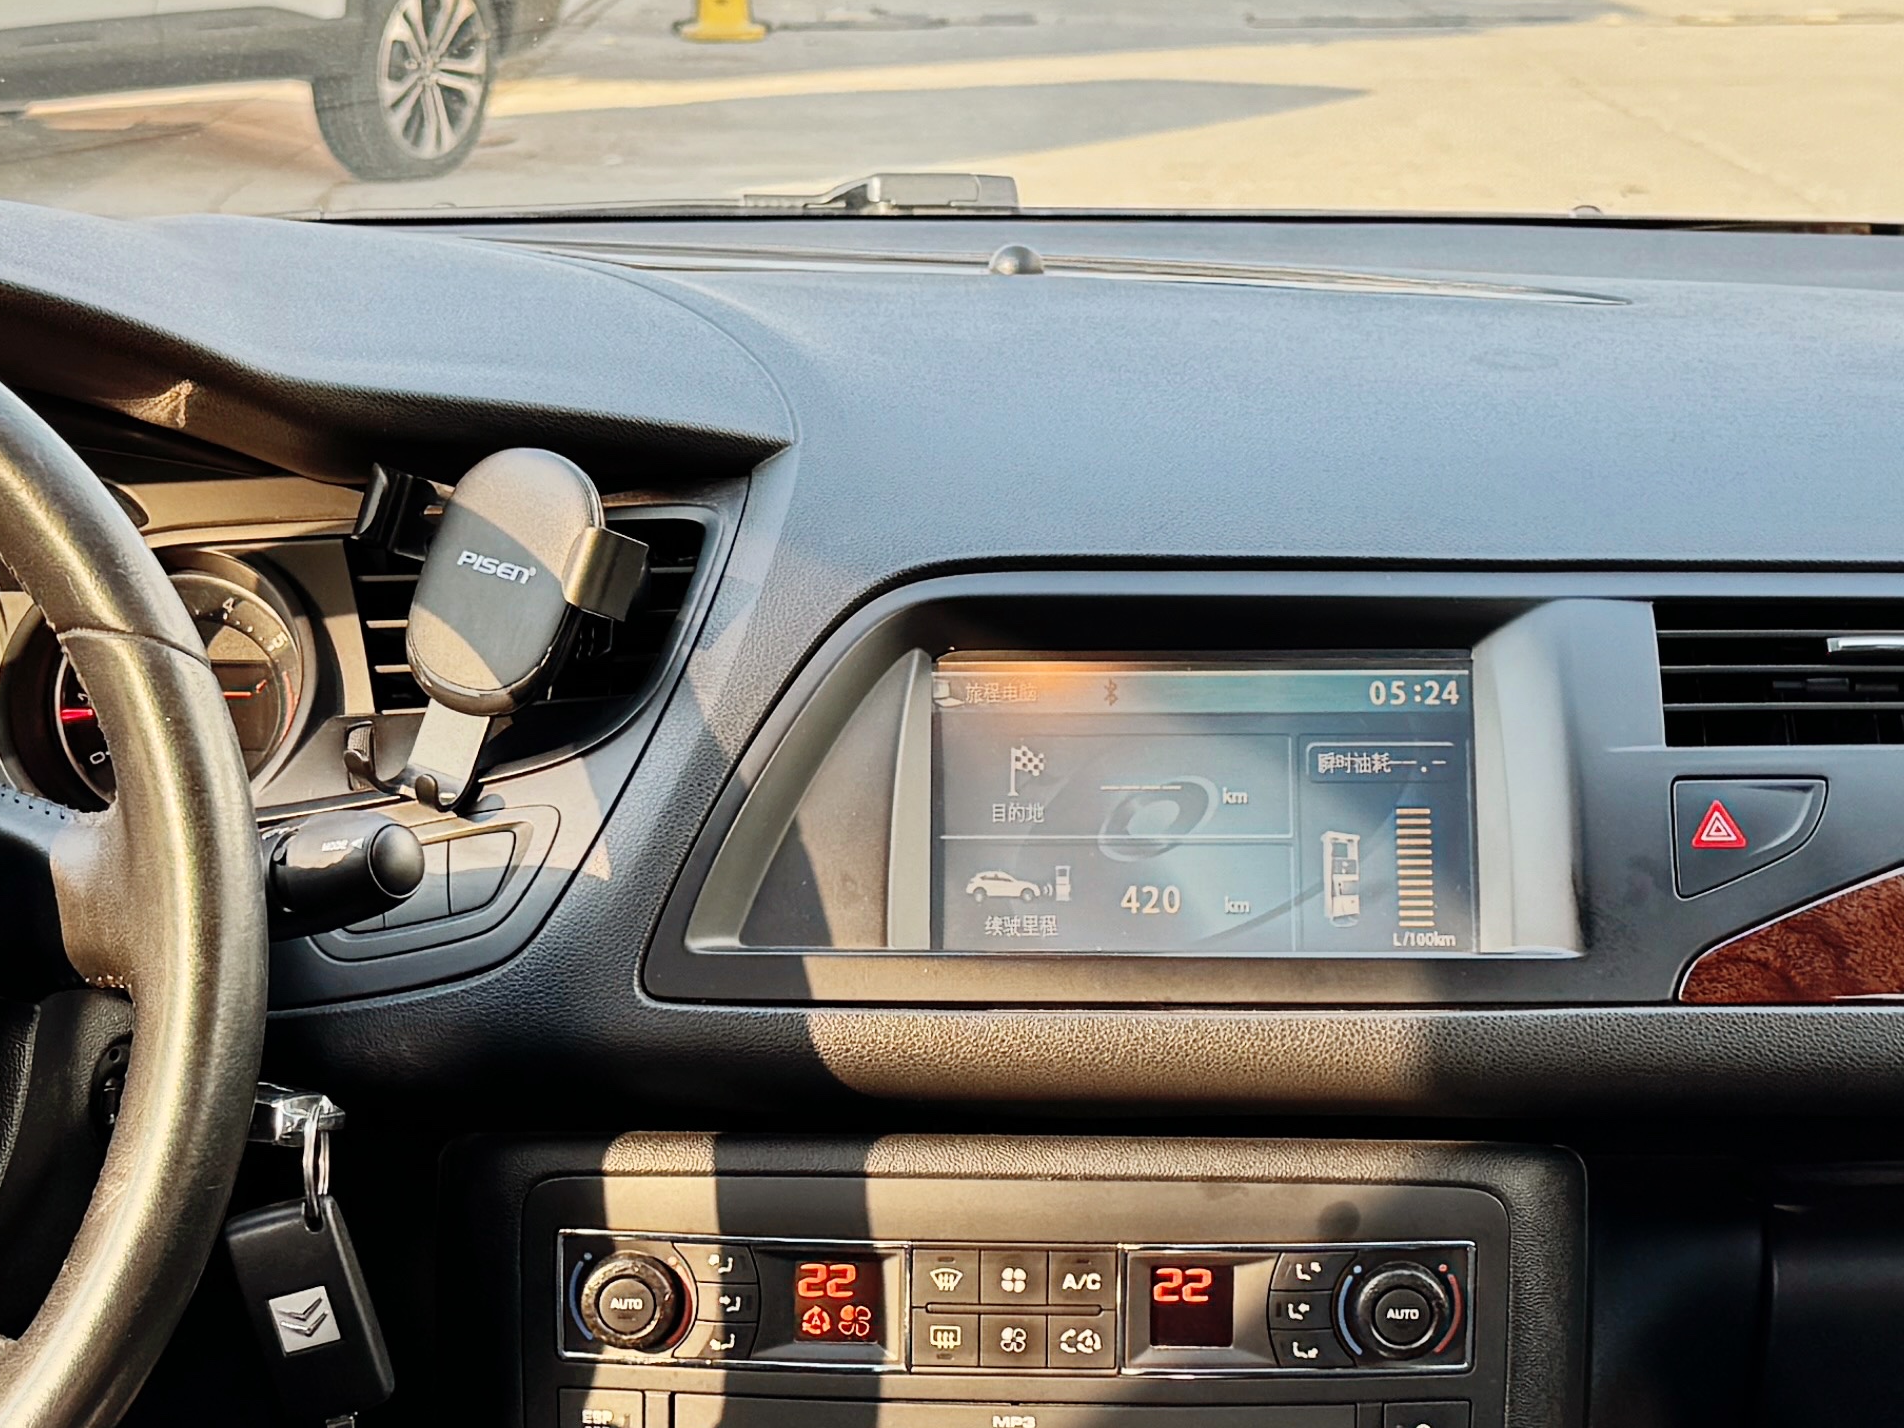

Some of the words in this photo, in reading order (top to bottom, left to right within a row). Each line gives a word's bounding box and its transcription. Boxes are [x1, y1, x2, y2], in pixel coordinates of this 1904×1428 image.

[457, 550, 536, 584] PISEN
[222, 597, 235, 614] 4
[273, 631, 289, 650] 5
[964, 681, 1039, 704] 旅程电脑
[1369, 680, 1459, 705] 05:24
[1222, 786, 1248, 805] km
[992, 802, 1045, 824] 目的地
[1121, 885, 1181, 914] 420
[1224, 896, 1251, 914] km
[984, 914, 1059, 938] 续驶里程
[1393, 931, 1457, 947] L/100km
[797, 1262, 856, 1298] 22
[1062, 1272, 1102, 1291] A/C
[1153, 1268, 1212, 1303] 22
[609, 1298, 643, 1310] AUTO
[1386, 1307, 1420, 1321] AUTO
[581, 1409, 614, 1425] ESP
[992, 1415, 1036, 1428] MP3
